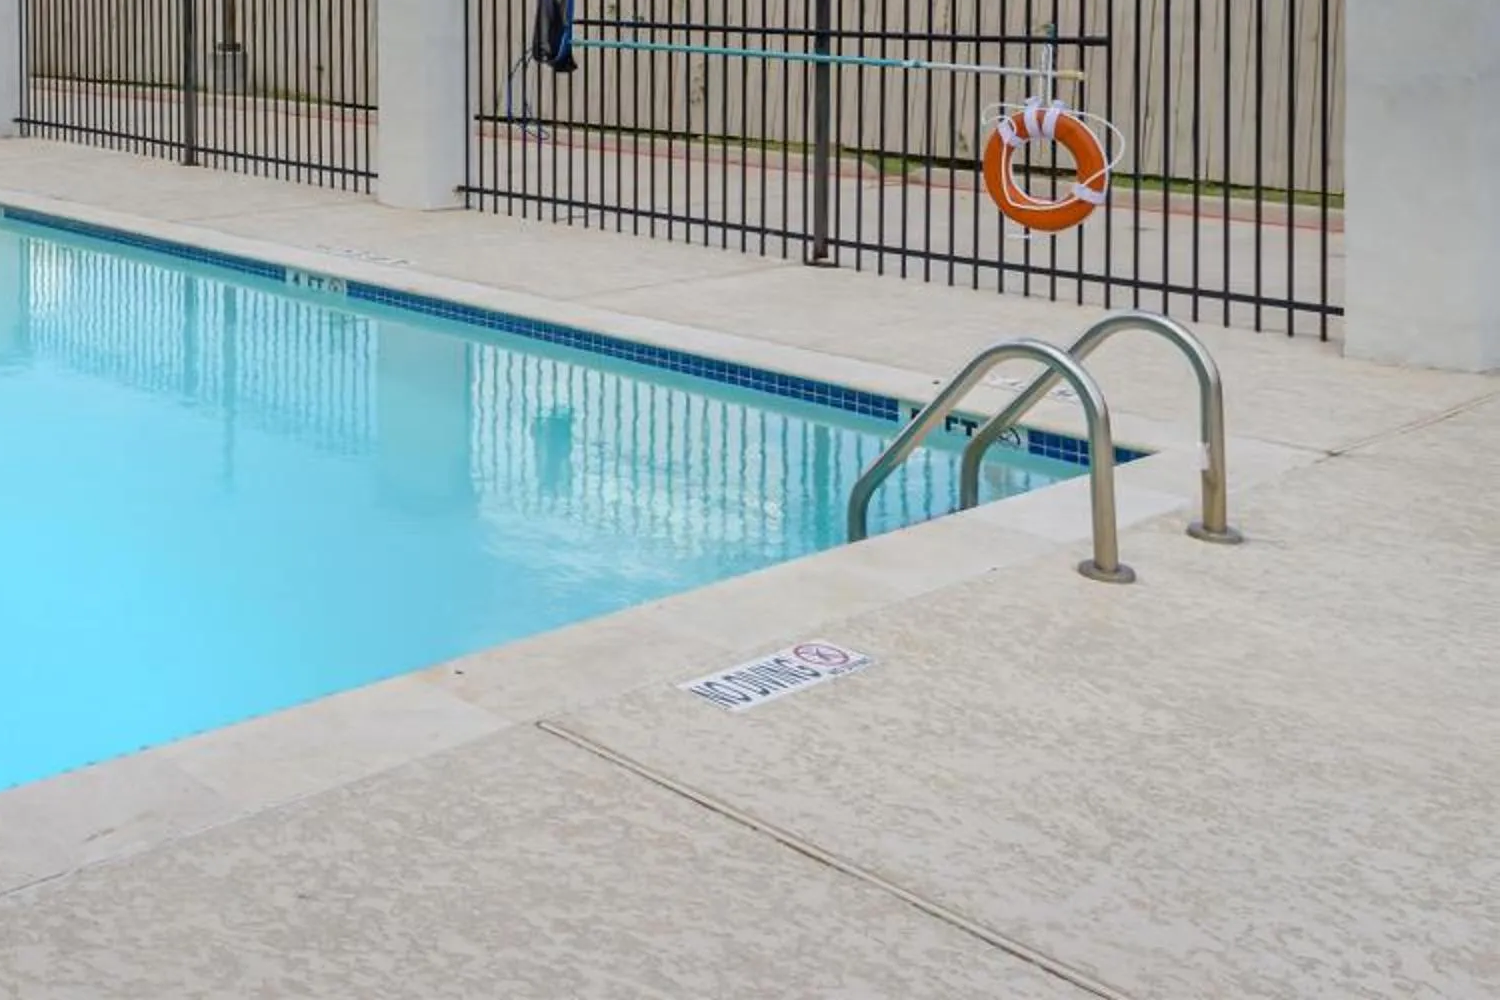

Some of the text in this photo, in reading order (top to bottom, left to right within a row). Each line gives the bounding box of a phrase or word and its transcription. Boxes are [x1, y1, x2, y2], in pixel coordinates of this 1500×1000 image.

[945, 415, 978, 437] FT
[690, 681, 752, 710] NO
[722, 658, 821, 697] DIVING
